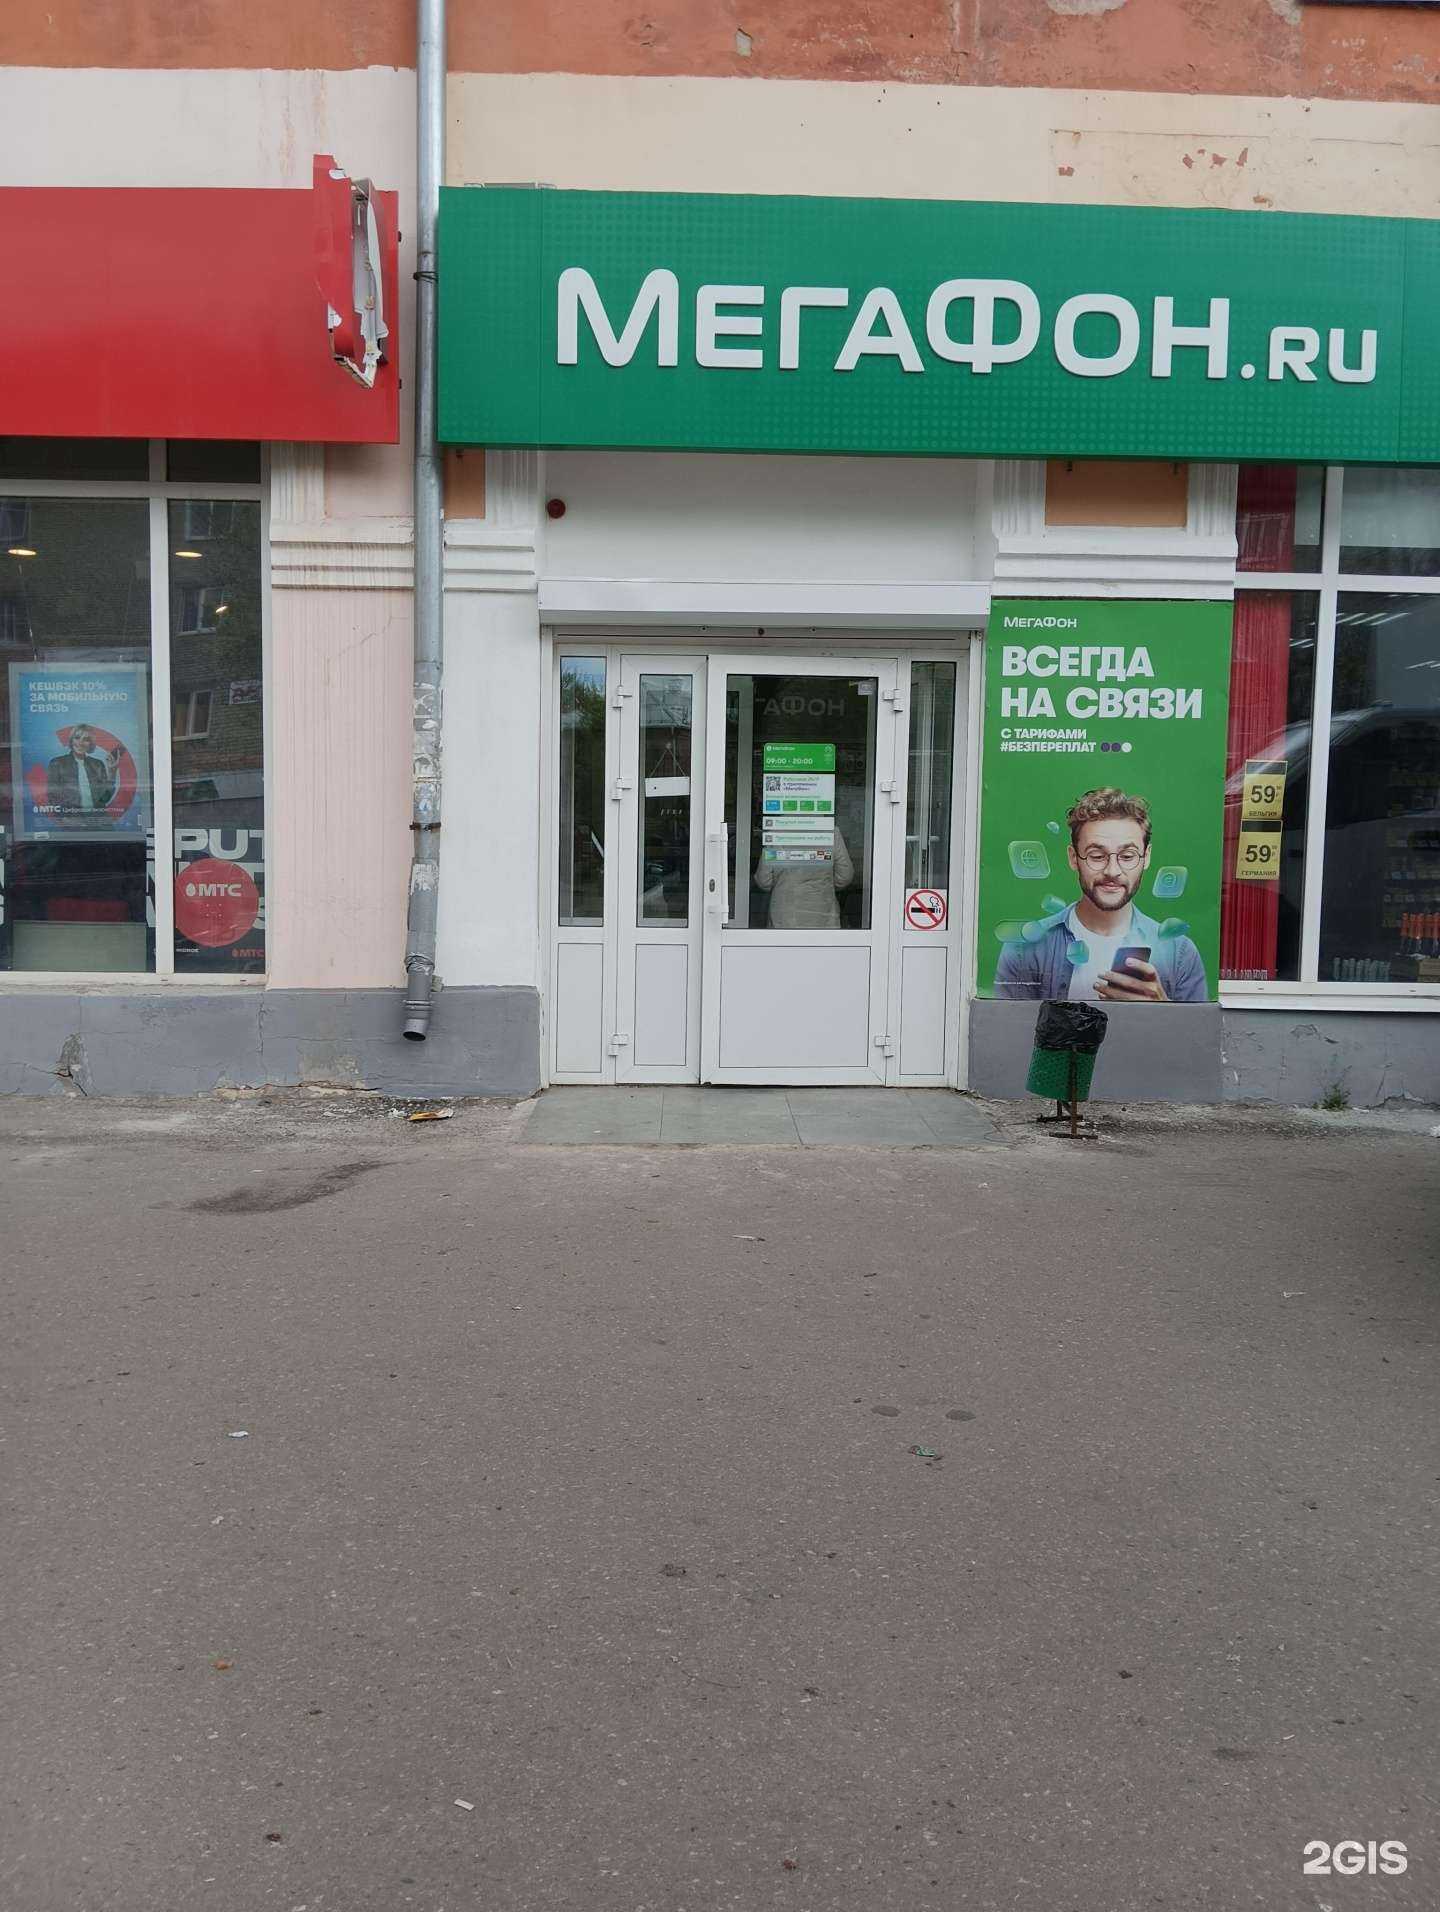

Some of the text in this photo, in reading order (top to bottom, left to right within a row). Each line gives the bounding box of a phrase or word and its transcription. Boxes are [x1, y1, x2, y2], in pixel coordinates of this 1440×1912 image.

[1002, 645, 1154, 681] ВСЕГДА
[29, 680, 106, 691] КЕШБЭК 10%
[30, 692, 128, 702] ЗА МОБИЛЬНУЮ
[1000, 686, 1203, 719] НА СВЯЗИ
[30, 703, 69, 713] СВЯЗЬ
[1000, 727, 1087, 740] С ТАРИФАМИ
[1000, 741, 1097, 753] #БЕЗПЕРЕПЛАТ
[1250, 785, 1276, 803] 59
[39, 805, 61, 813] МТС
[1245, 844, 1272, 863] 59
[199, 882, 242, 897] МТС
